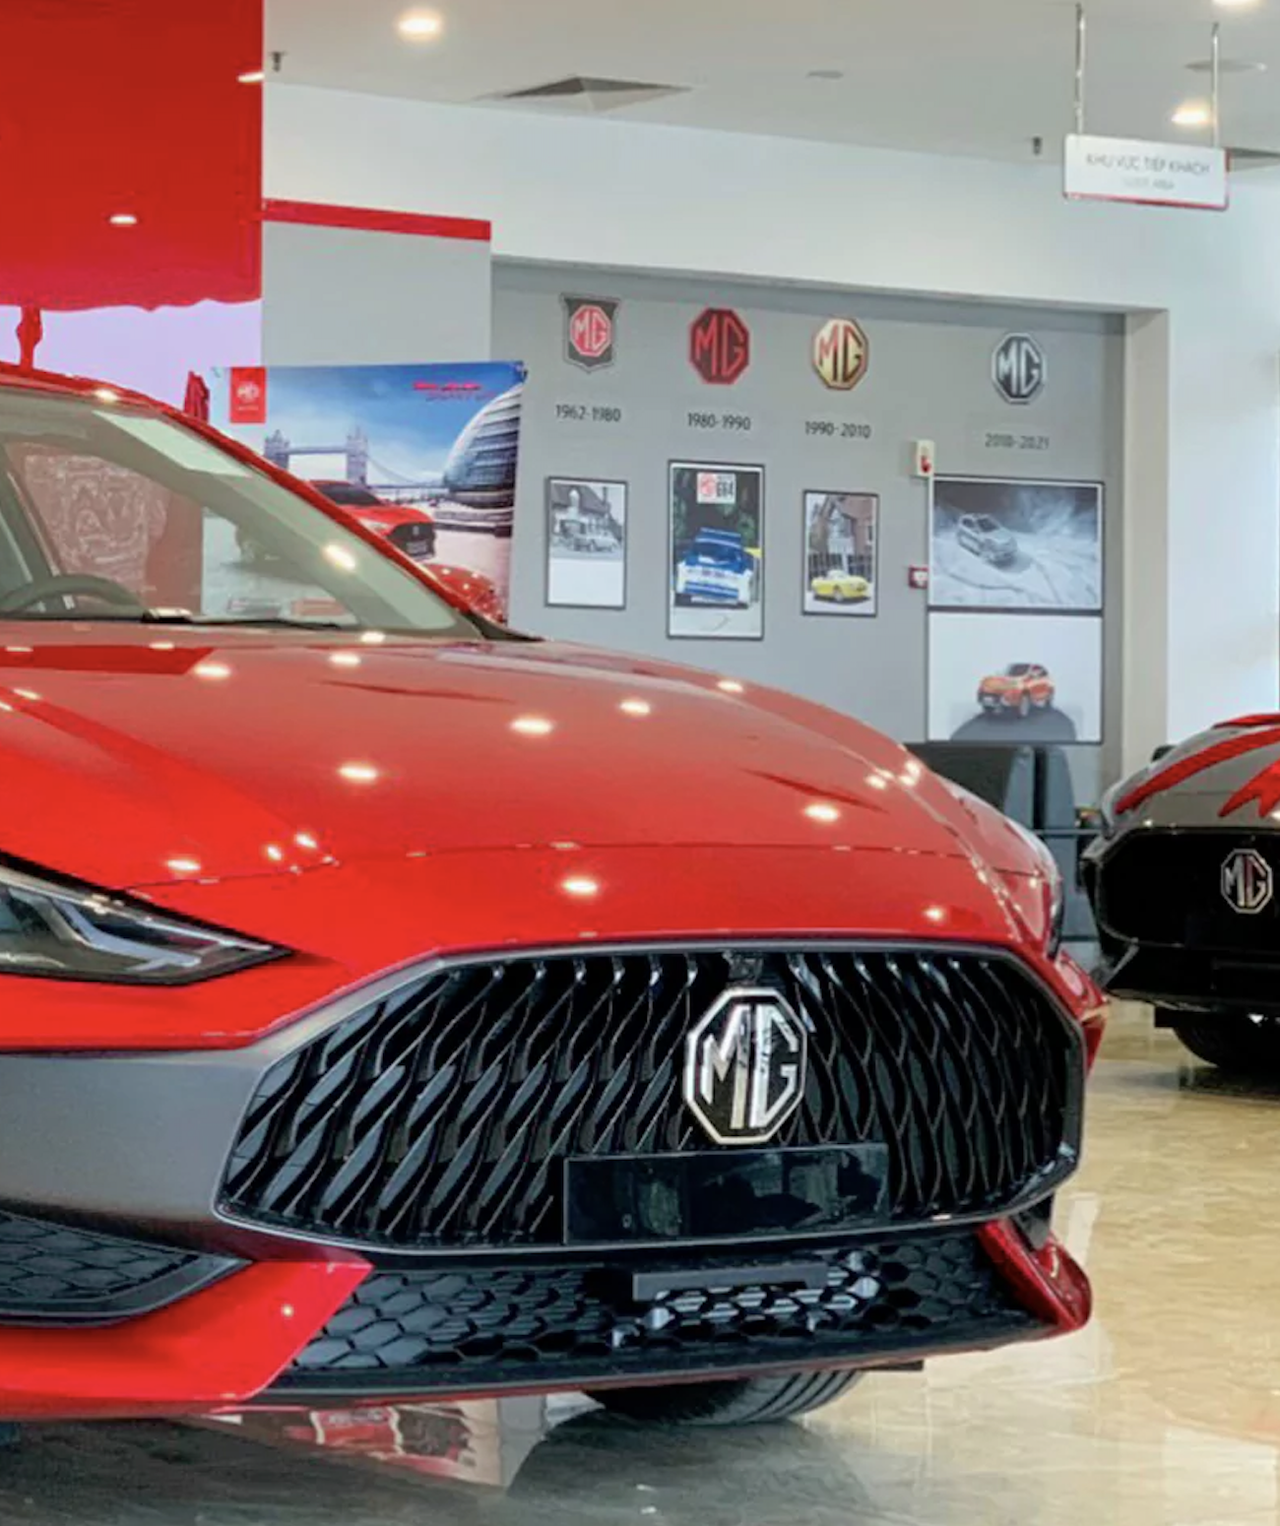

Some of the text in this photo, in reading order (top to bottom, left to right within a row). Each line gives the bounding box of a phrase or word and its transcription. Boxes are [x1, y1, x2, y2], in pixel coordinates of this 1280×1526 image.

[1086, 153, 1111, 168] KHU
[574, 310, 608, 352] MG
[695, 313, 745, 376] MG
[819, 323, 863, 383] MG
[998, 340, 1041, 396] MG
[1224, 854, 1266, 908] MG
[700, 1004, 799, 1130] MG
